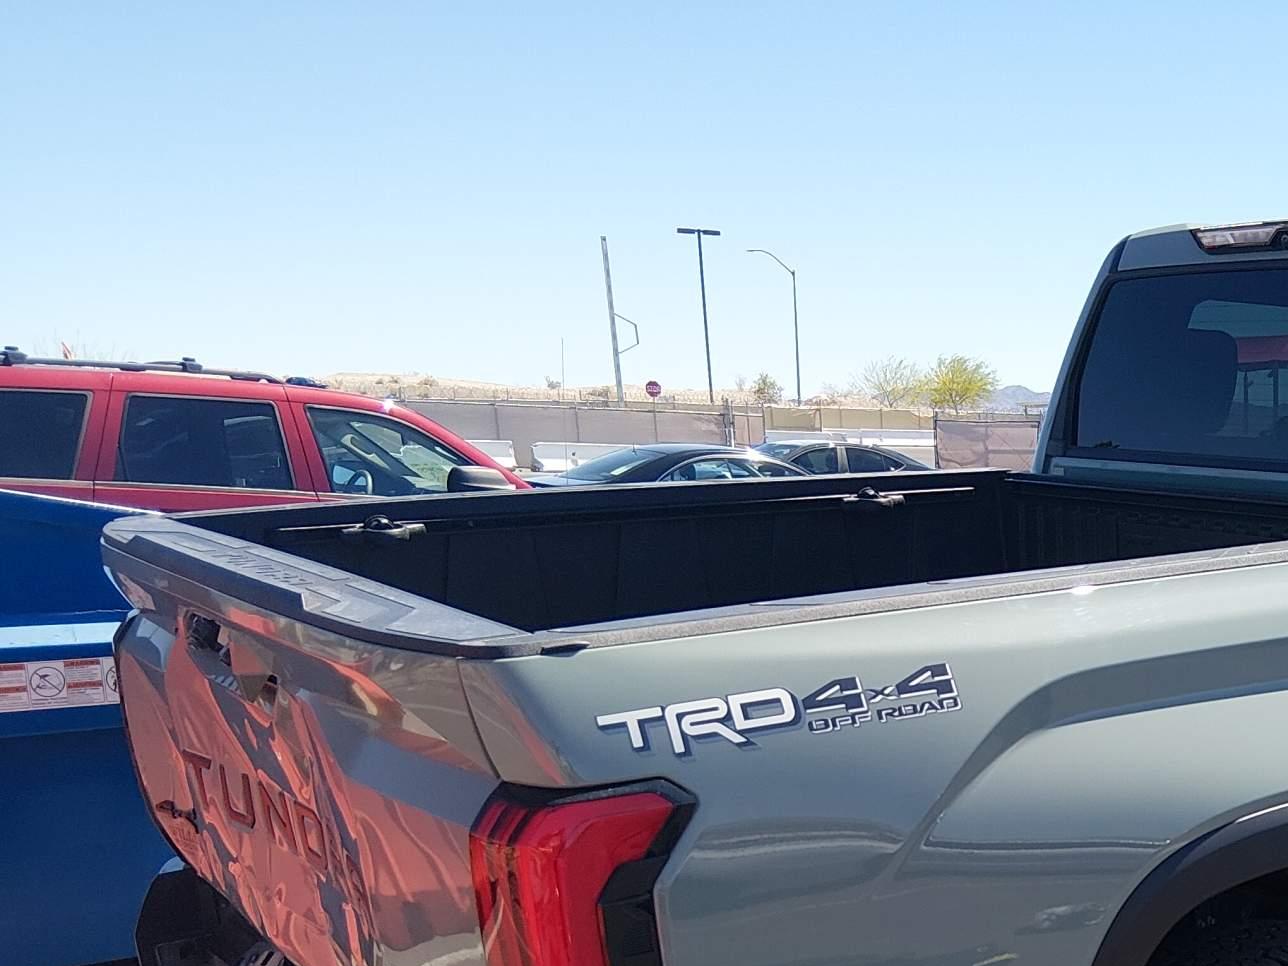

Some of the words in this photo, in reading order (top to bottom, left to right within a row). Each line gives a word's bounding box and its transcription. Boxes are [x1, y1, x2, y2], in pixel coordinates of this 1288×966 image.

[596, 689, 805, 756] TRD
[808, 711, 872, 734] OFF
[876, 697, 962, 722] ROAD
